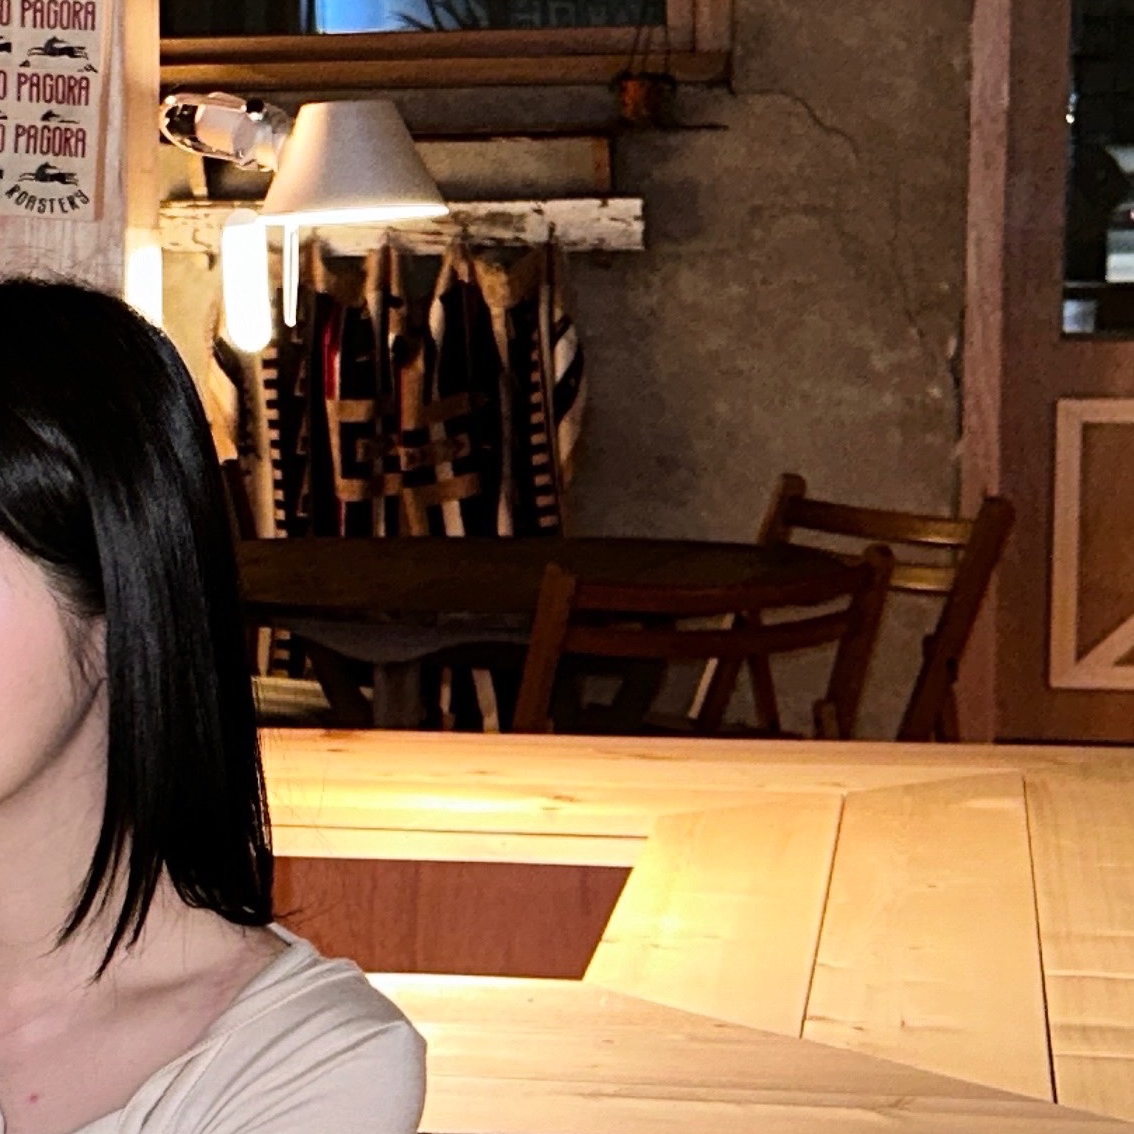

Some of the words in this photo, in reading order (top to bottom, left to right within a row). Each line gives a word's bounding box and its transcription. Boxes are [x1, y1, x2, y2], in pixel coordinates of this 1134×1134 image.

[20, 1, 96, 31] PAGORA
[16, 73, 90, 106] PAGORA
[14, 124, 87, 158] PAGORA
[5, 184, 90, 214] ROASTERY
